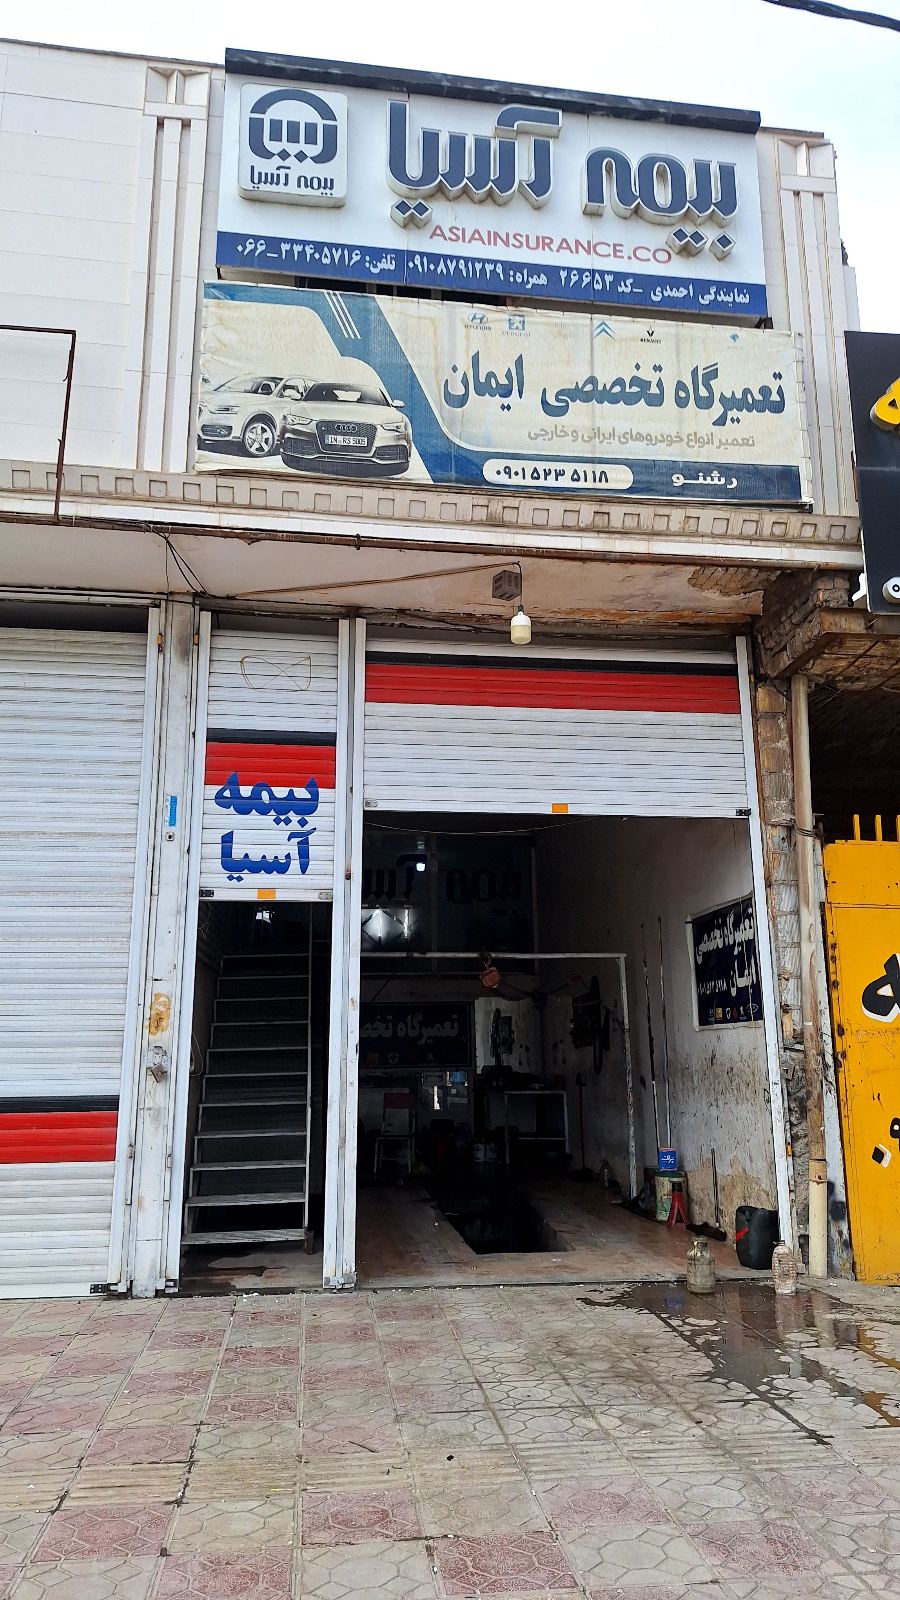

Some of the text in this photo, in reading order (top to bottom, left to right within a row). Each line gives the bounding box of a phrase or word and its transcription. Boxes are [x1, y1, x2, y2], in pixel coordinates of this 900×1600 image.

[250, 165, 335, 196] بیمه آسیا
[387, 99, 739, 256] بیمه آسیا
[429, 224, 672, 264] ASIAINSURANCE.CO
[408, 254, 504, 281] ۰۹۱۰۸۷۹۱۲۳۹
[559, 268, 614, 291] ۲۶۶۵۳
[650, 283, 694, 302] احمدی
[698, 286, 750, 308] نمایندگی
[443, 349, 786, 427] تعمیرگاه تخصصی ایمان
[527, 424, 570, 442] خارجی
[570, 429, 579, 443] و
[580, 427, 616, 445] ایرانی
[685, 431, 715, 449] انواع
[715, 434, 756, 451] تعمیر
[214, 771, 320, 828] بیمه
[220, 827, 317, 883] آسیا
[394, 1011, 462, 1047] تعمیرگاه
